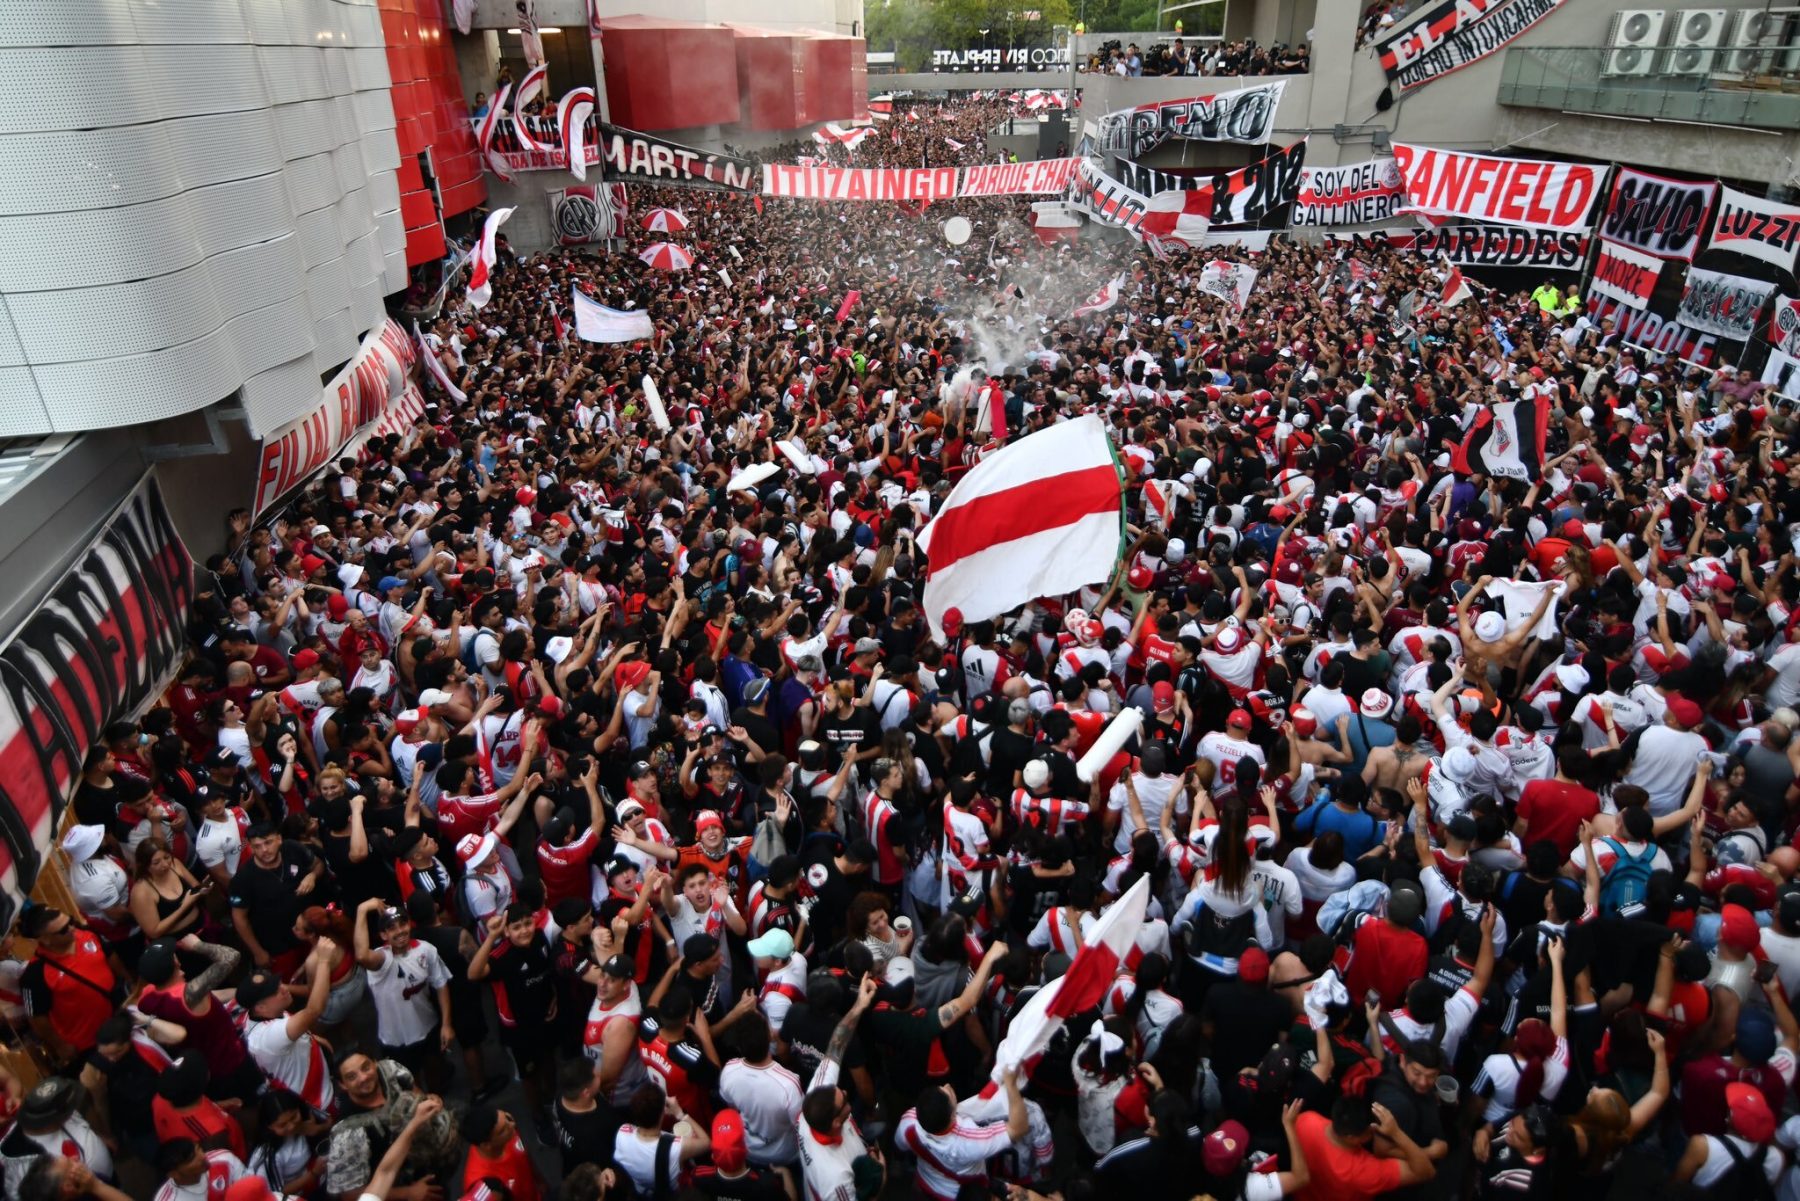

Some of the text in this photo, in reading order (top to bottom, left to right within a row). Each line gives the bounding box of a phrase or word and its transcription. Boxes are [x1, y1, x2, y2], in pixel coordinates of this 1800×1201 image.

[1388, 21, 1445, 71] EL
[965, 163, 1034, 195] PARQUE
[1314, 164, 1379, 197] SOY DEL
[1393, 145, 1594, 227] BANFIELD
[1292, 192, 1401, 226] GALLINERO
[1606, 176, 1705, 251] SAVIO
[1411, 226, 1582, 268] PAREDES
[255, 405, 331, 513] FILIAL
[1264, 696, 1286, 707] BORJA
[1268, 708, 1286, 729] 9
